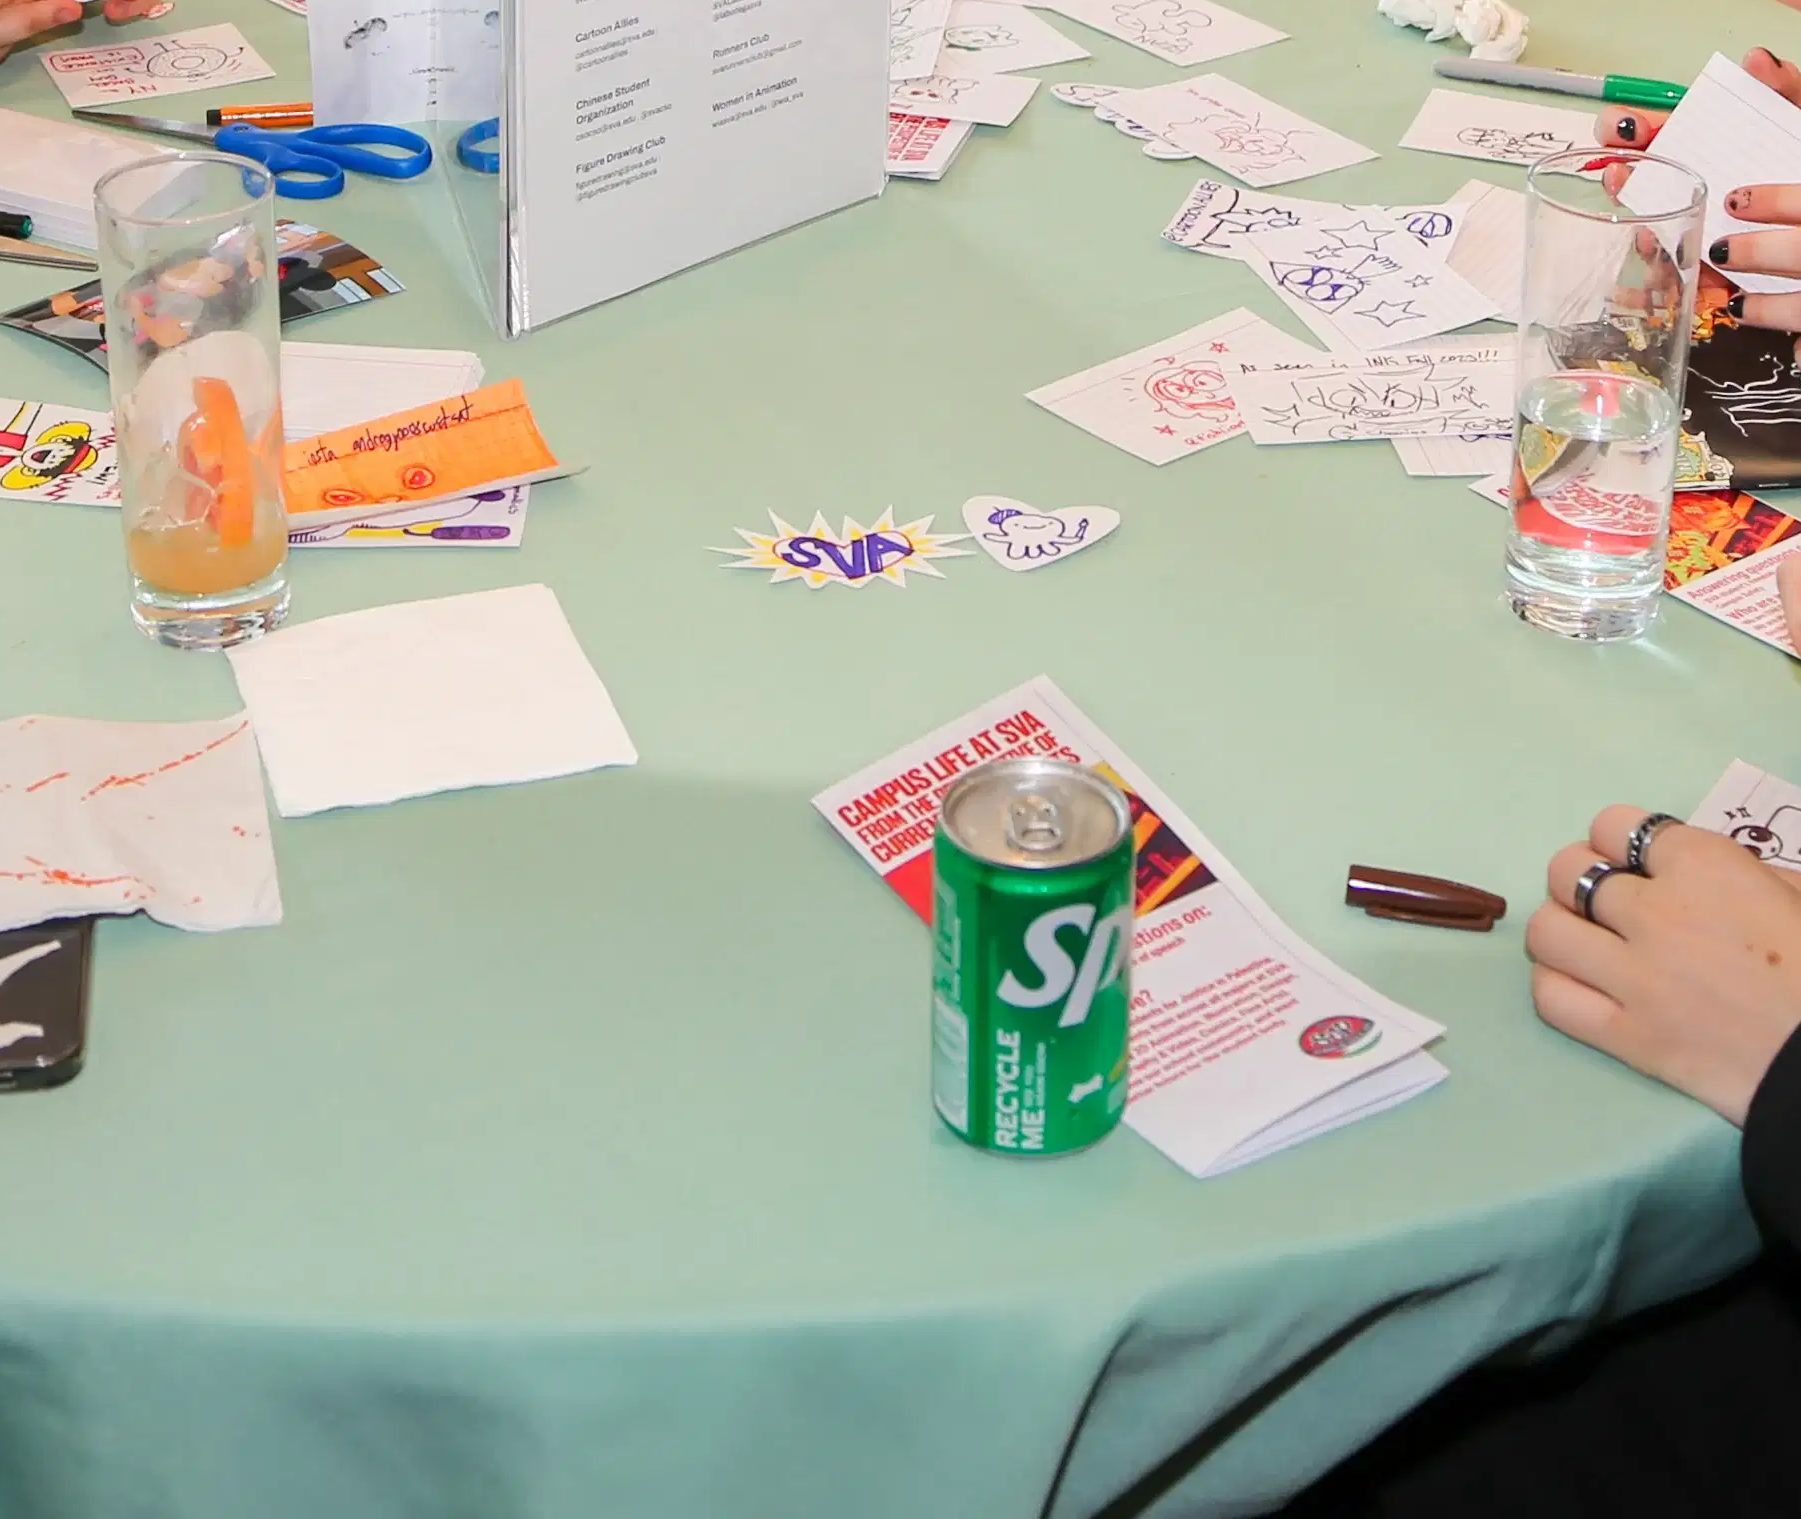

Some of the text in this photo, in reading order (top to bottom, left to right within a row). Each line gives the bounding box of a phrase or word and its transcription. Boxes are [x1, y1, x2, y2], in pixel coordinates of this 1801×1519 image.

[575, 16, 639, 42] Cartoon Allies
[712, 33, 770, 59] Runners Club
[575, 78, 651, 110] Chinese Student
[712, 77, 798, 112] Women in Animation
[575, 99, 634, 125] Organization
[575, 135, 666, 174] Figure Drawing Club
[1331, 359, 1349, 370] in
[781, 533, 915, 580] SVA
[1687, 570, 1745, 599] Answering
[1727, 604, 1757, 620] Who
[837, 767, 932, 828] CAMPUS
[924, 743, 976, 782] LIFE
[969, 730, 1001, 760] AT
[995, 710, 1046, 746] SVA
[856, 811, 908, 846] FROM
[902, 796, 938, 819] THE
[1034, 732, 1060, 751] OF
[1183, 905, 1212, 924] on:
[995, 1028, 1021, 1149] RECYCLE
[1022, 1109, 1046, 1150] ME
